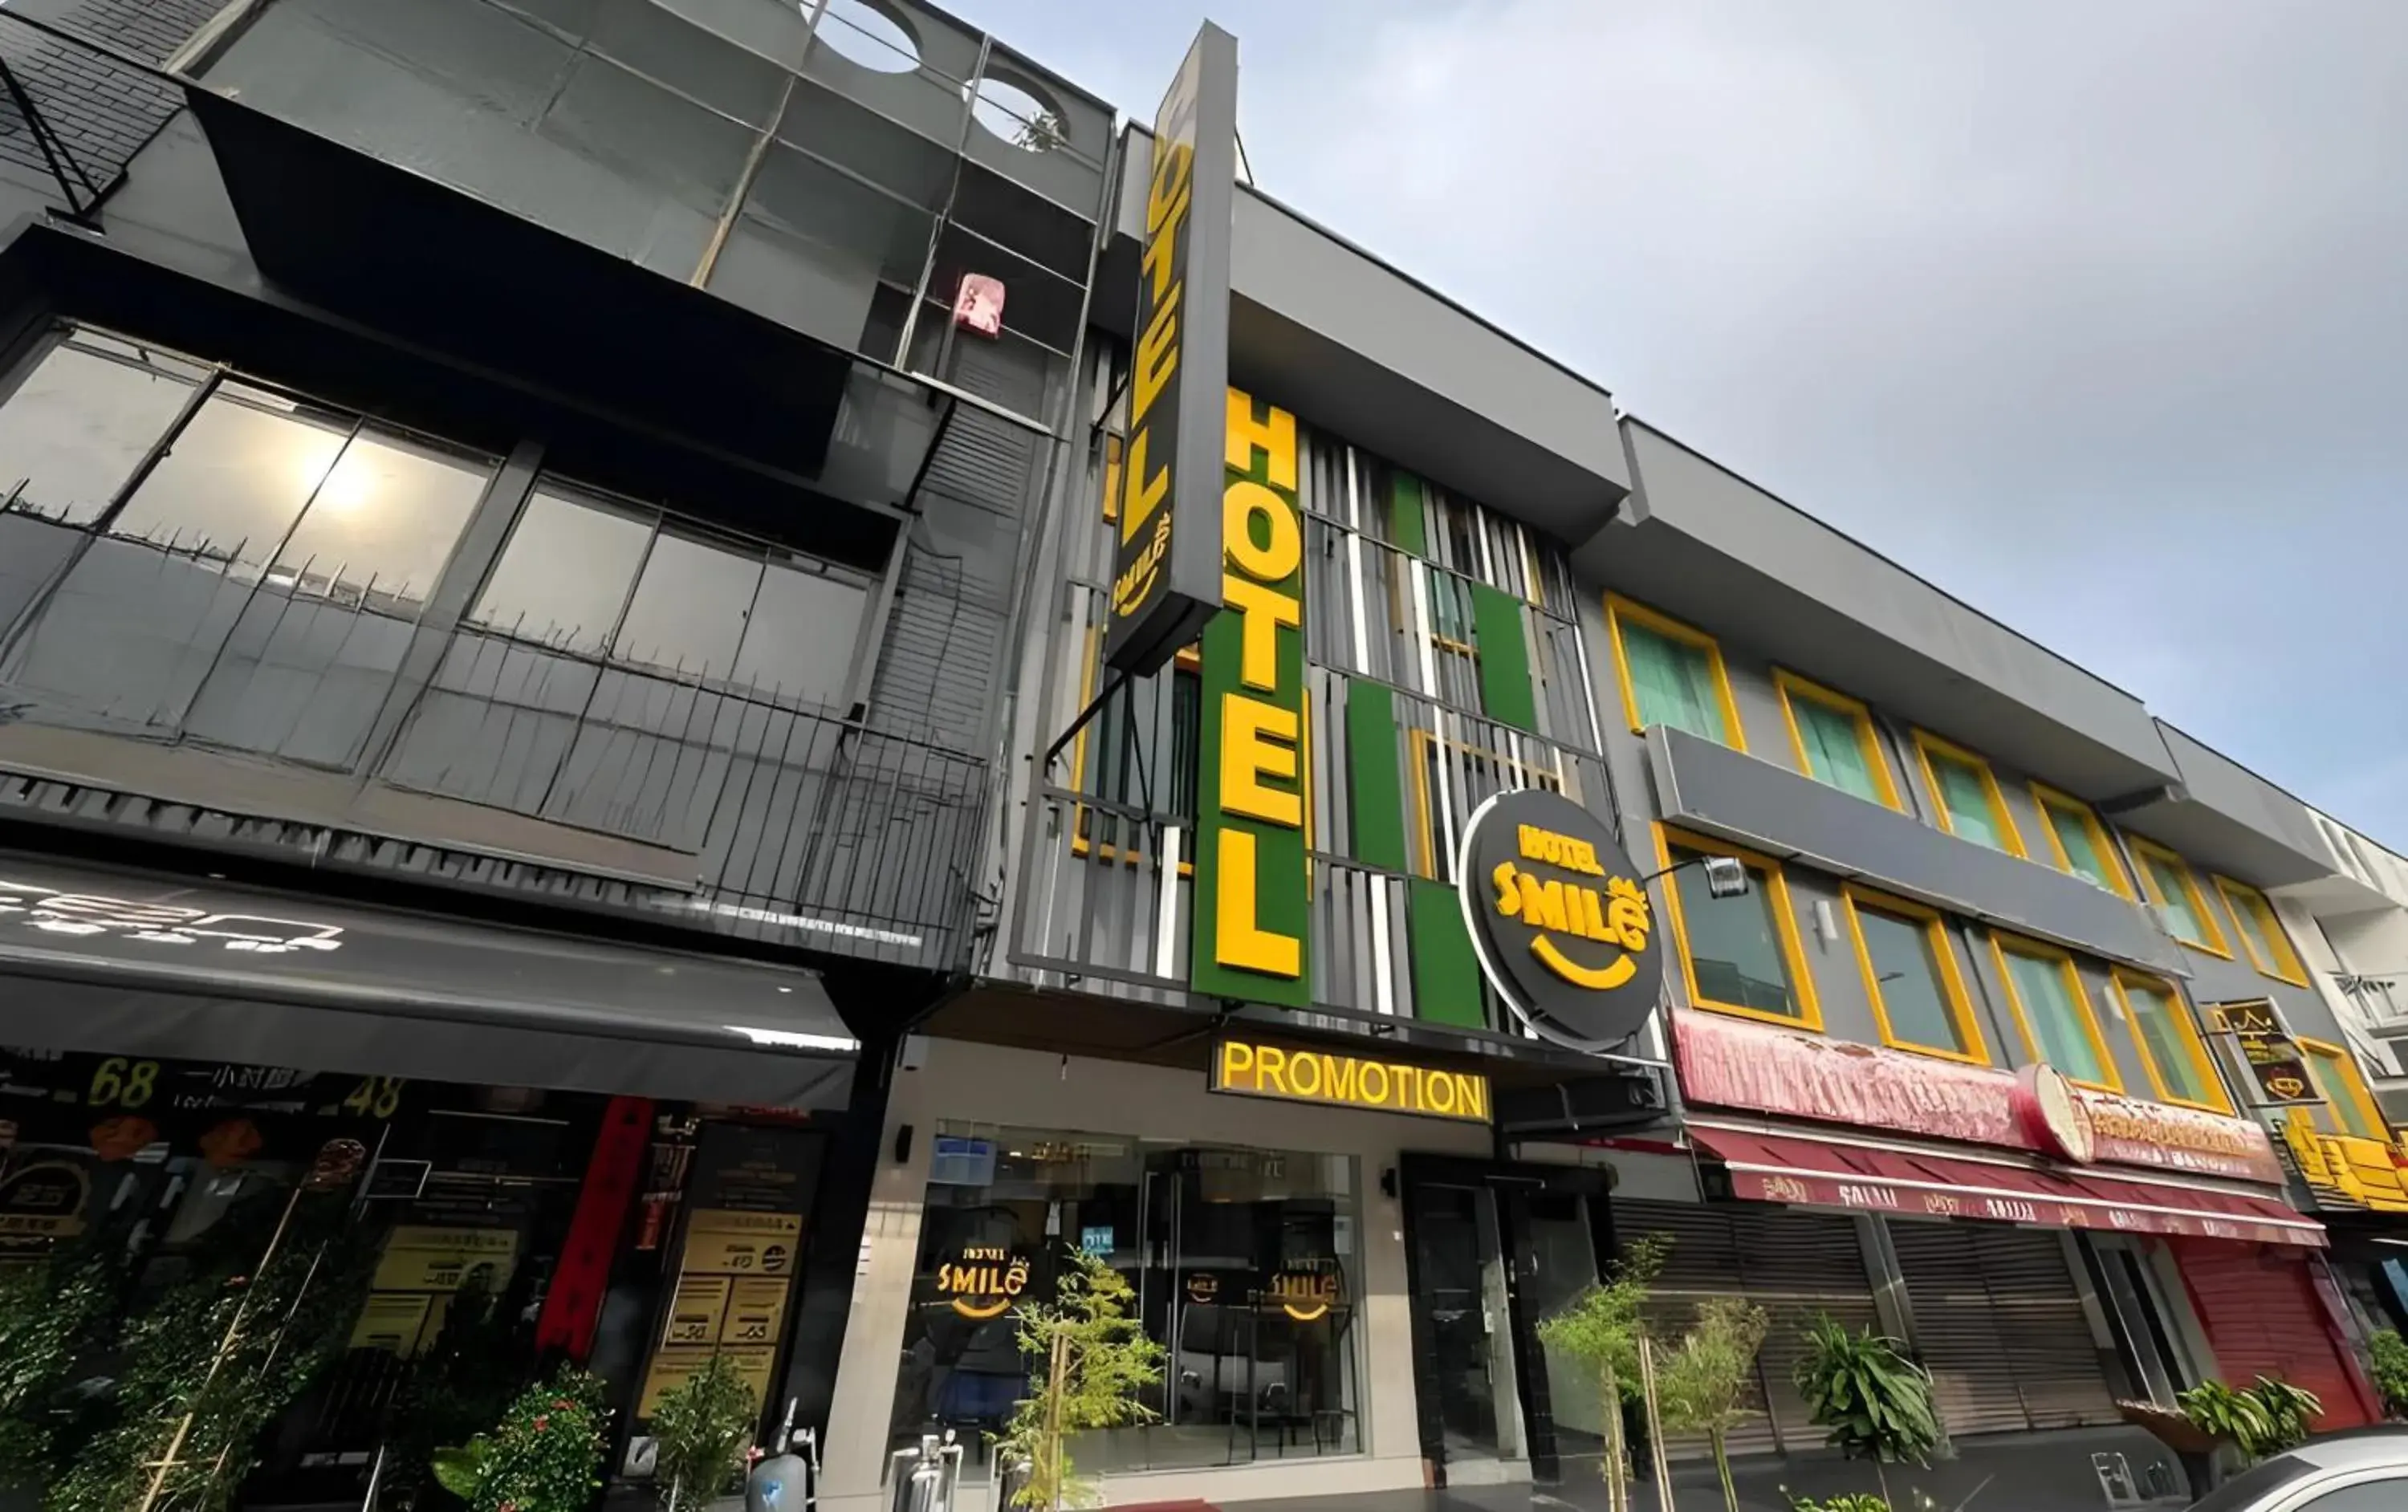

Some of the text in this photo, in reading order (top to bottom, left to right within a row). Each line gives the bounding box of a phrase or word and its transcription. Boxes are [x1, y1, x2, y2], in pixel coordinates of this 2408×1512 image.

[1216, 388, 1302, 978] HOTEL
[87, 1057, 160, 1109] 68
[1222, 1041, 1487, 1117] PROMOTION
